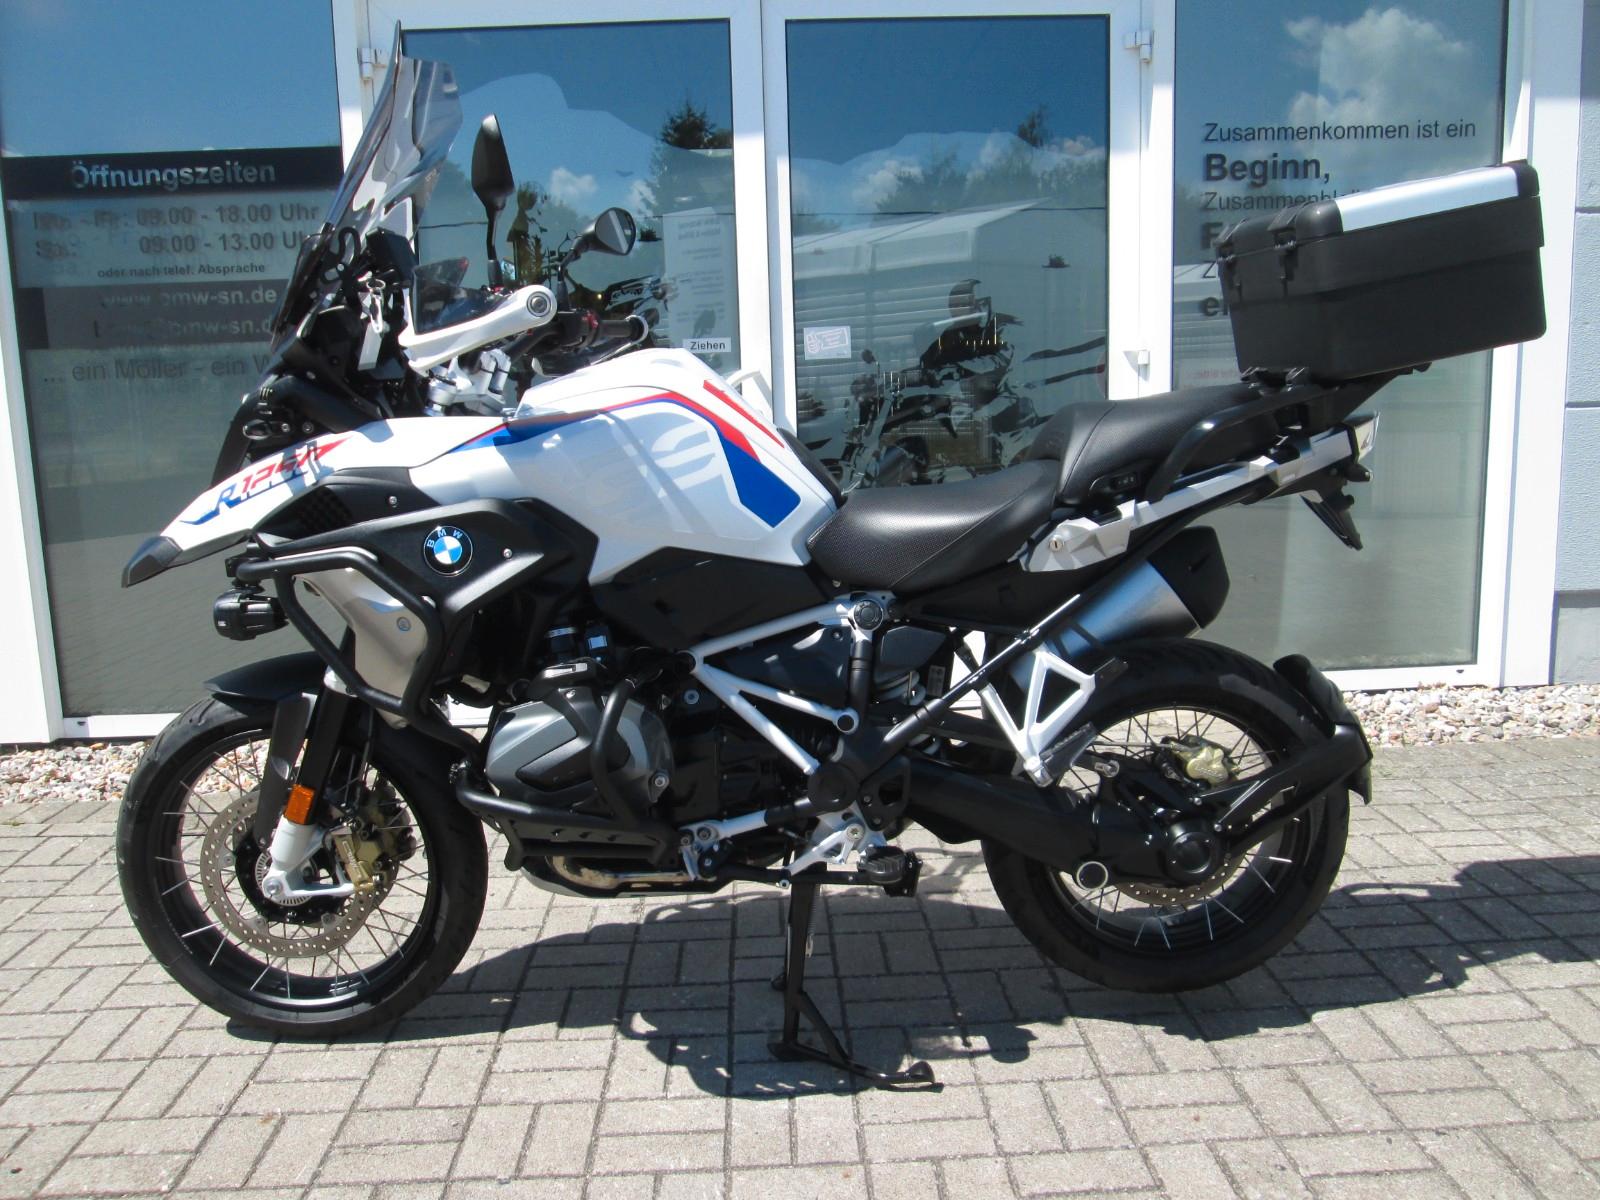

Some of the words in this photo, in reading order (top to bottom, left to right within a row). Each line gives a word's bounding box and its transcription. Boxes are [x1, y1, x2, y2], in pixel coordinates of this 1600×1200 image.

[1204, 121, 1409, 143] Zusammenkommen
[1417, 120, 1440, 139] ist
[1446, 119, 1477, 138] ein
[71, 160, 276, 192] Öffnungszeiten
[1205, 153, 1330, 187] Beginn,
[215, 203, 272, 224] 18.00
[280, 202, 321, 221] Uhr
[218, 231, 275, 252] 13.00
[198, 262, 265, 277] Absprache
[689, 340, 726, 351] Ziehen
[211, 356, 246, 377] ein
[426, 528, 463, 549] BMW
